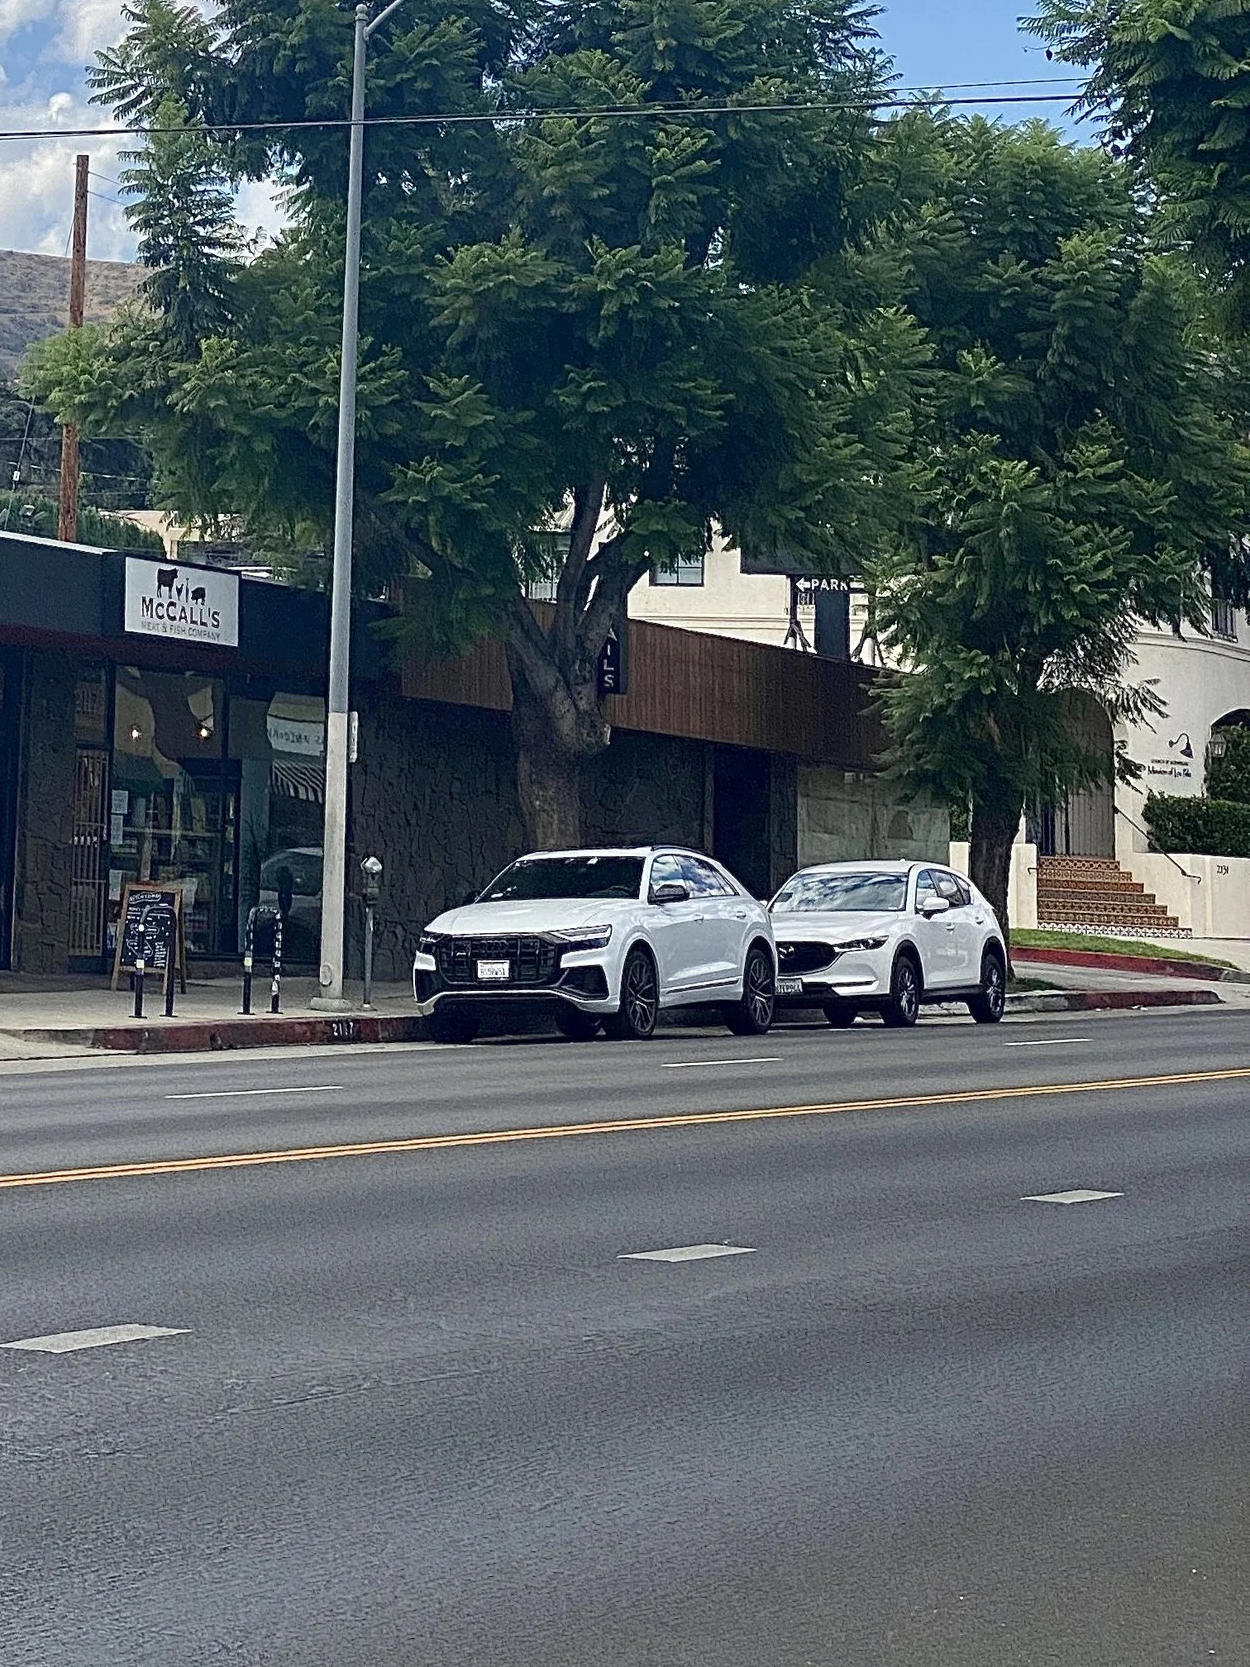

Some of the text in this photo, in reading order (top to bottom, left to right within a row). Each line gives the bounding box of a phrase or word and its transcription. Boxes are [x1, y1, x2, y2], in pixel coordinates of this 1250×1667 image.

[141, 596, 221, 629] McCALL'S
[141, 621, 160, 631] MEAT
[170, 624, 186, 635] FISH
[188, 627, 220, 641] COMPANY
